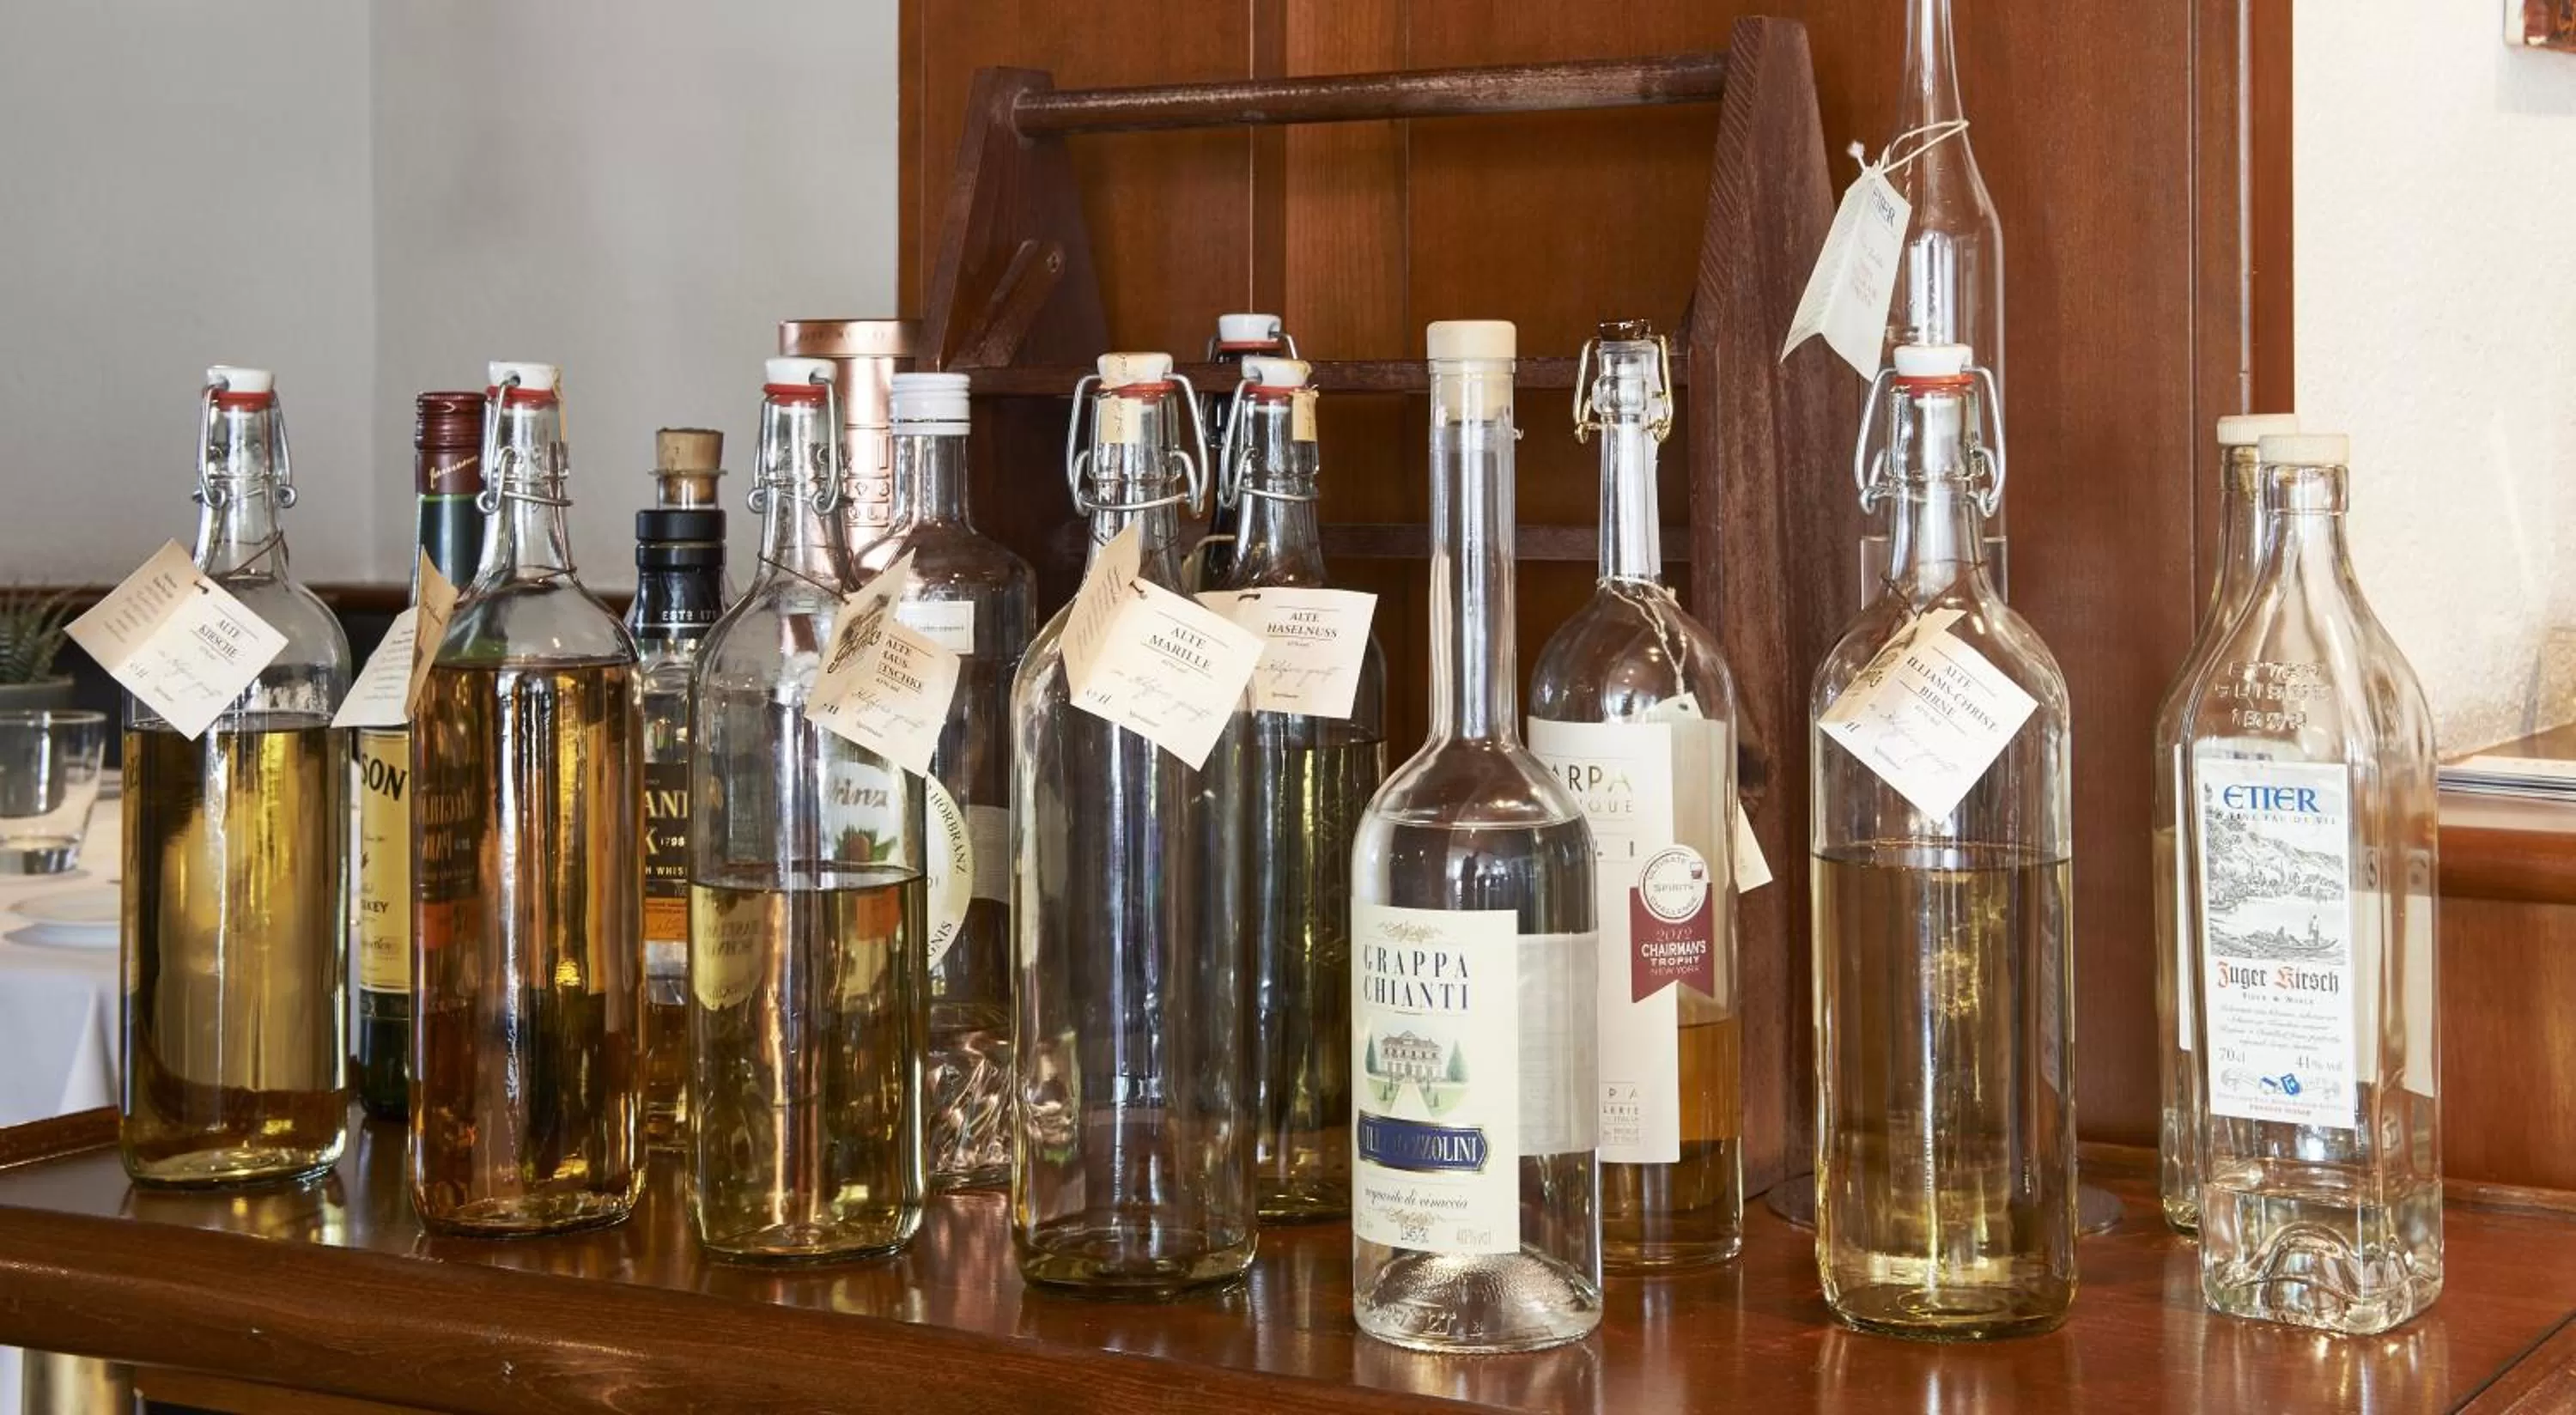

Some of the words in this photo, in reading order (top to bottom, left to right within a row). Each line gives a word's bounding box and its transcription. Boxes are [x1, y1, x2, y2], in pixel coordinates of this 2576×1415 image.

[1288, 610, 1321, 624] ALTE
[1170, 626, 1207, 649] ALTE
[1267, 622, 1340, 640] HASELNUSS
[885, 638, 912, 657] ALTE
[1148, 634, 1212, 671] MARILLE
[1944, 665, 1972, 690] ALTE
[1918, 685, 1957, 718] BIRNE
[361, 751, 407, 801] SON
[2223, 783, 2321, 813] ETTER
[656, 865, 688, 877] WHIS
[1656, 927, 1693, 942] 2012
[1641, 940, 1707, 957] CHAIRMAN'S
[1364, 944, 1468, 979] GRAPPA
[1650, 955, 1700, 967] TROPHY
[1650, 966, 1674, 976] NEW
[1676, 964, 1700, 976] YORK
[2218, 961, 2268, 989] Zuger
[2274, 965, 2339, 994] Kirsch
[1364, 975, 1468, 1011] CHIANTI
